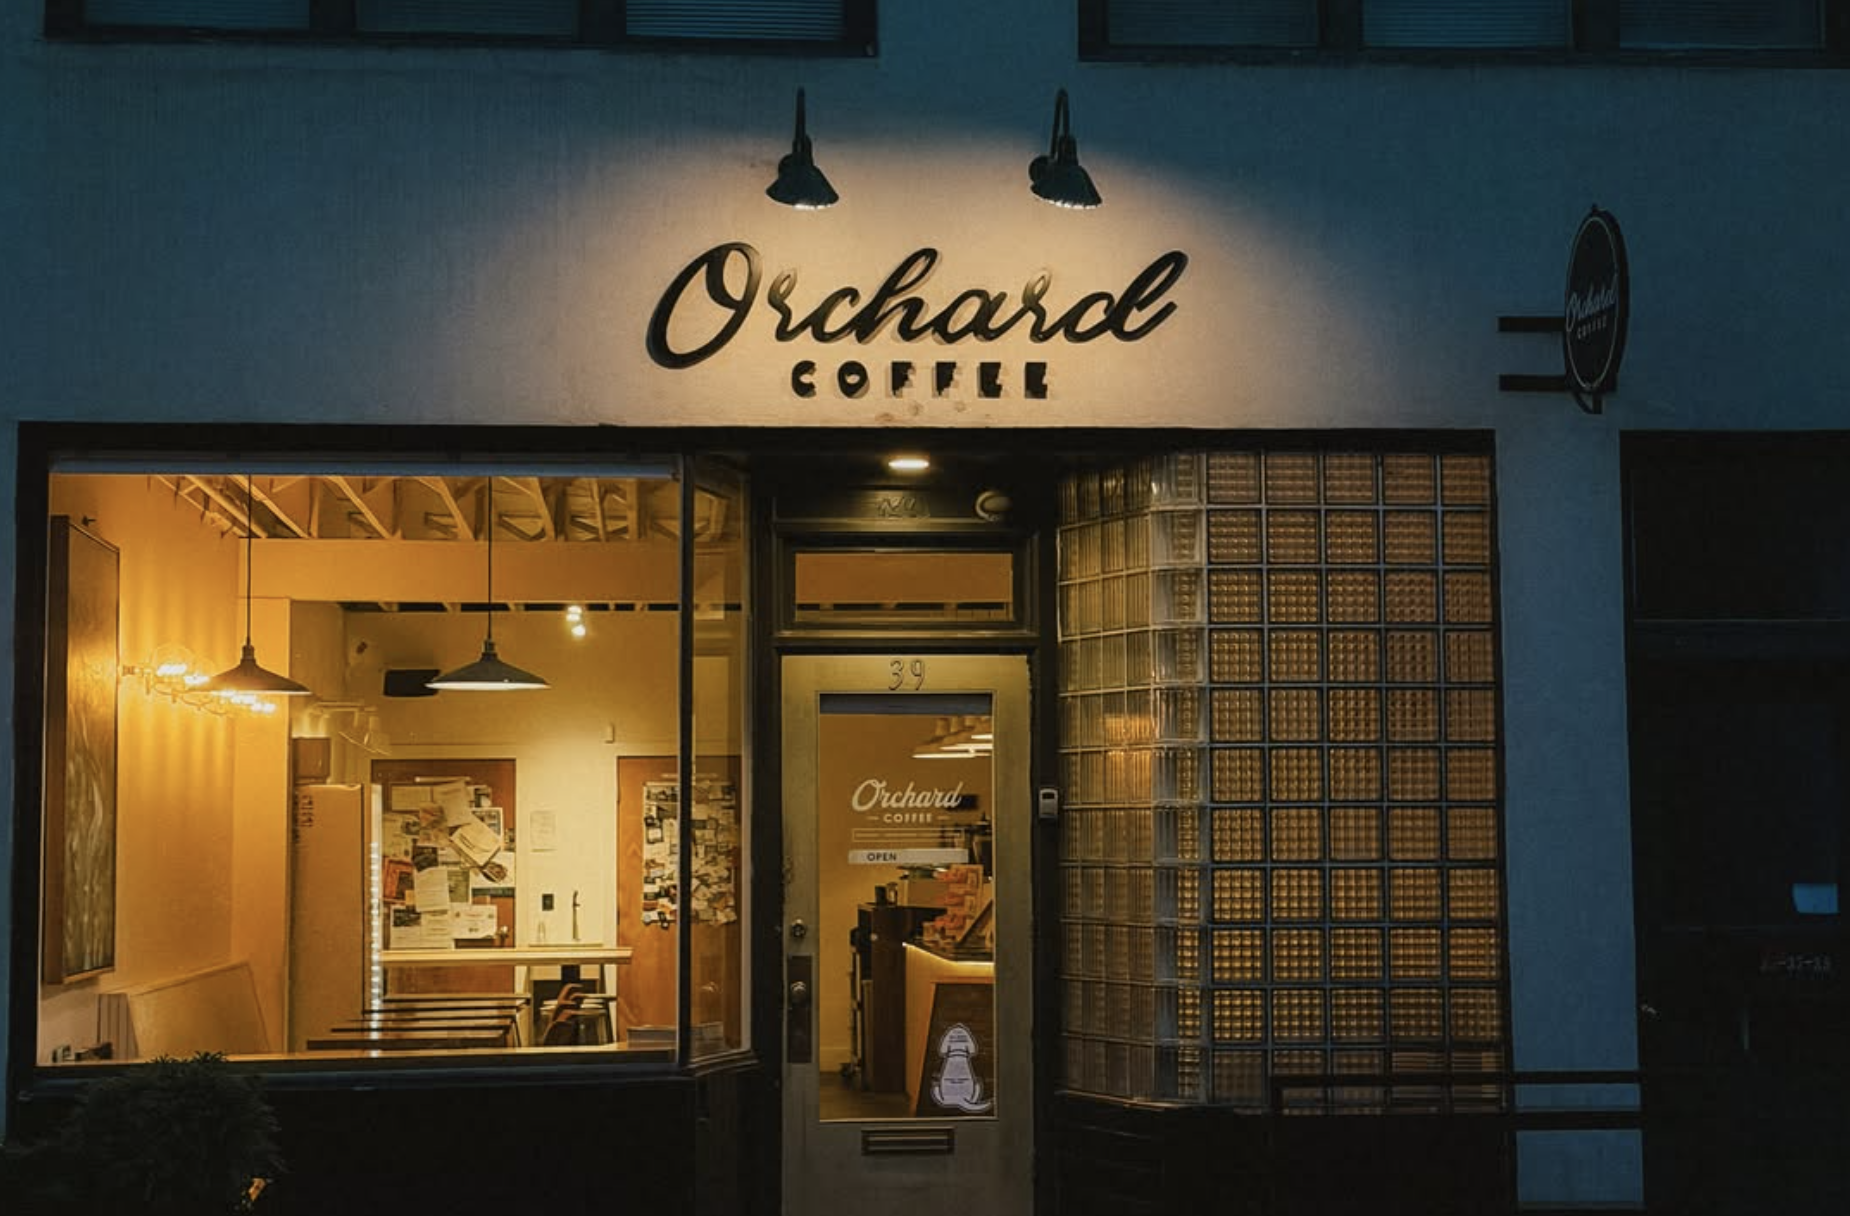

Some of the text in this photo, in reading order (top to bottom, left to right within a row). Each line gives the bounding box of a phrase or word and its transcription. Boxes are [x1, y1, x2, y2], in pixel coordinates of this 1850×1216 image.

[646, 241, 1189, 369] Orchard
[790, 360, 1048, 398] COFFEE
[888, 659, 925, 691] 39
[852, 779, 963, 811] Orchard
[883, 813, 932, 823] COFFEE
[866, 852, 897, 861] OPEN
